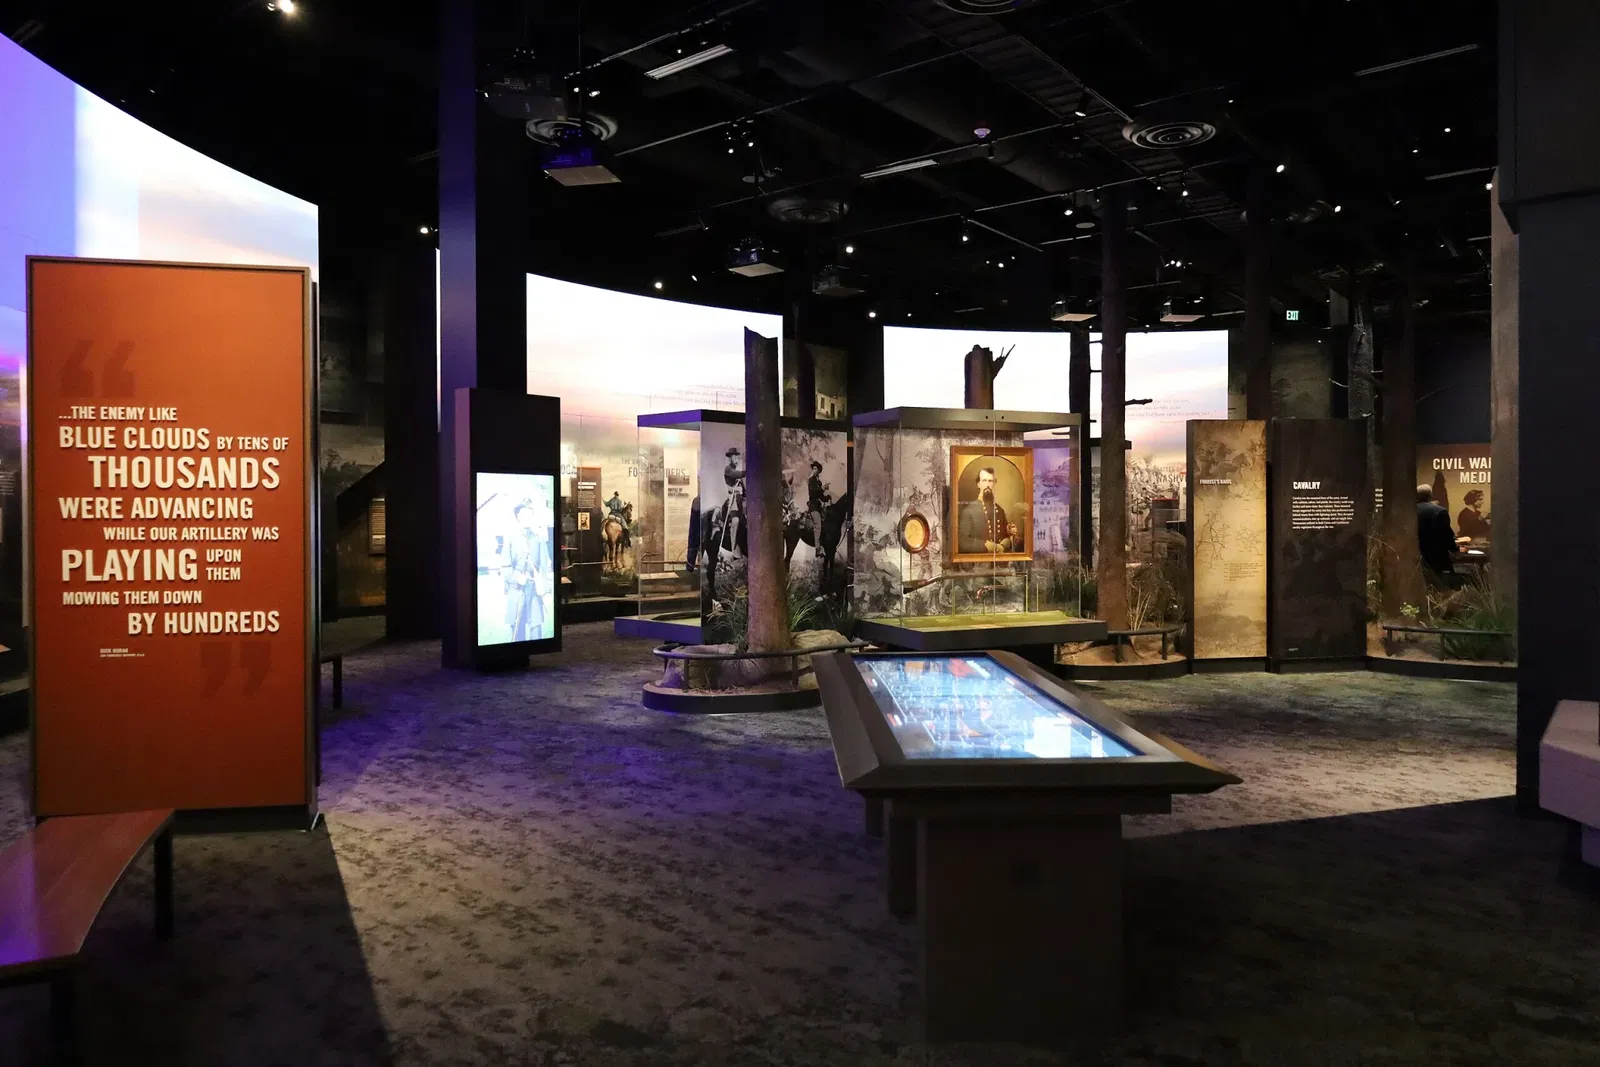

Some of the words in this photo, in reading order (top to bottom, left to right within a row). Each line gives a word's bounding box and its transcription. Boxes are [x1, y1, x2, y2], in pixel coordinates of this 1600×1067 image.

[1286, 310, 1300, 321] EXIT
[100, 406, 146, 421] ENEMY
[149, 407, 178, 421] LIKE
[59, 426, 117, 449] BLUE
[123, 426, 210, 450] CLOUDS
[216, 436, 234, 450] BY
[236, 436, 269, 451] TENS
[272, 436, 290, 451] OF
[1432, 457, 1465, 470] CIVIL
[87, 455, 281, 489] THOUSANDS
[1292, 481, 1321, 490] CAVALRY
[59, 496, 124, 519] WERE
[130, 496, 254, 519] ADVANCING
[103, 526, 146, 541] WHILE
[150, 526, 178, 541] OUR
[181, 526, 248, 541] ARTILLERY
[251, 526, 279, 541] WAS
[206, 548, 242, 563] UPON
[62, 548, 199, 582] PLAYING
[205, 567, 241, 581] THEM
[63, 591, 120, 605] MOWING
[123, 590, 159, 605] THEM
[163, 590, 202, 605] DOWN
[128, 612, 157, 635] BY
[164, 610, 280, 634] HUNDREDS
